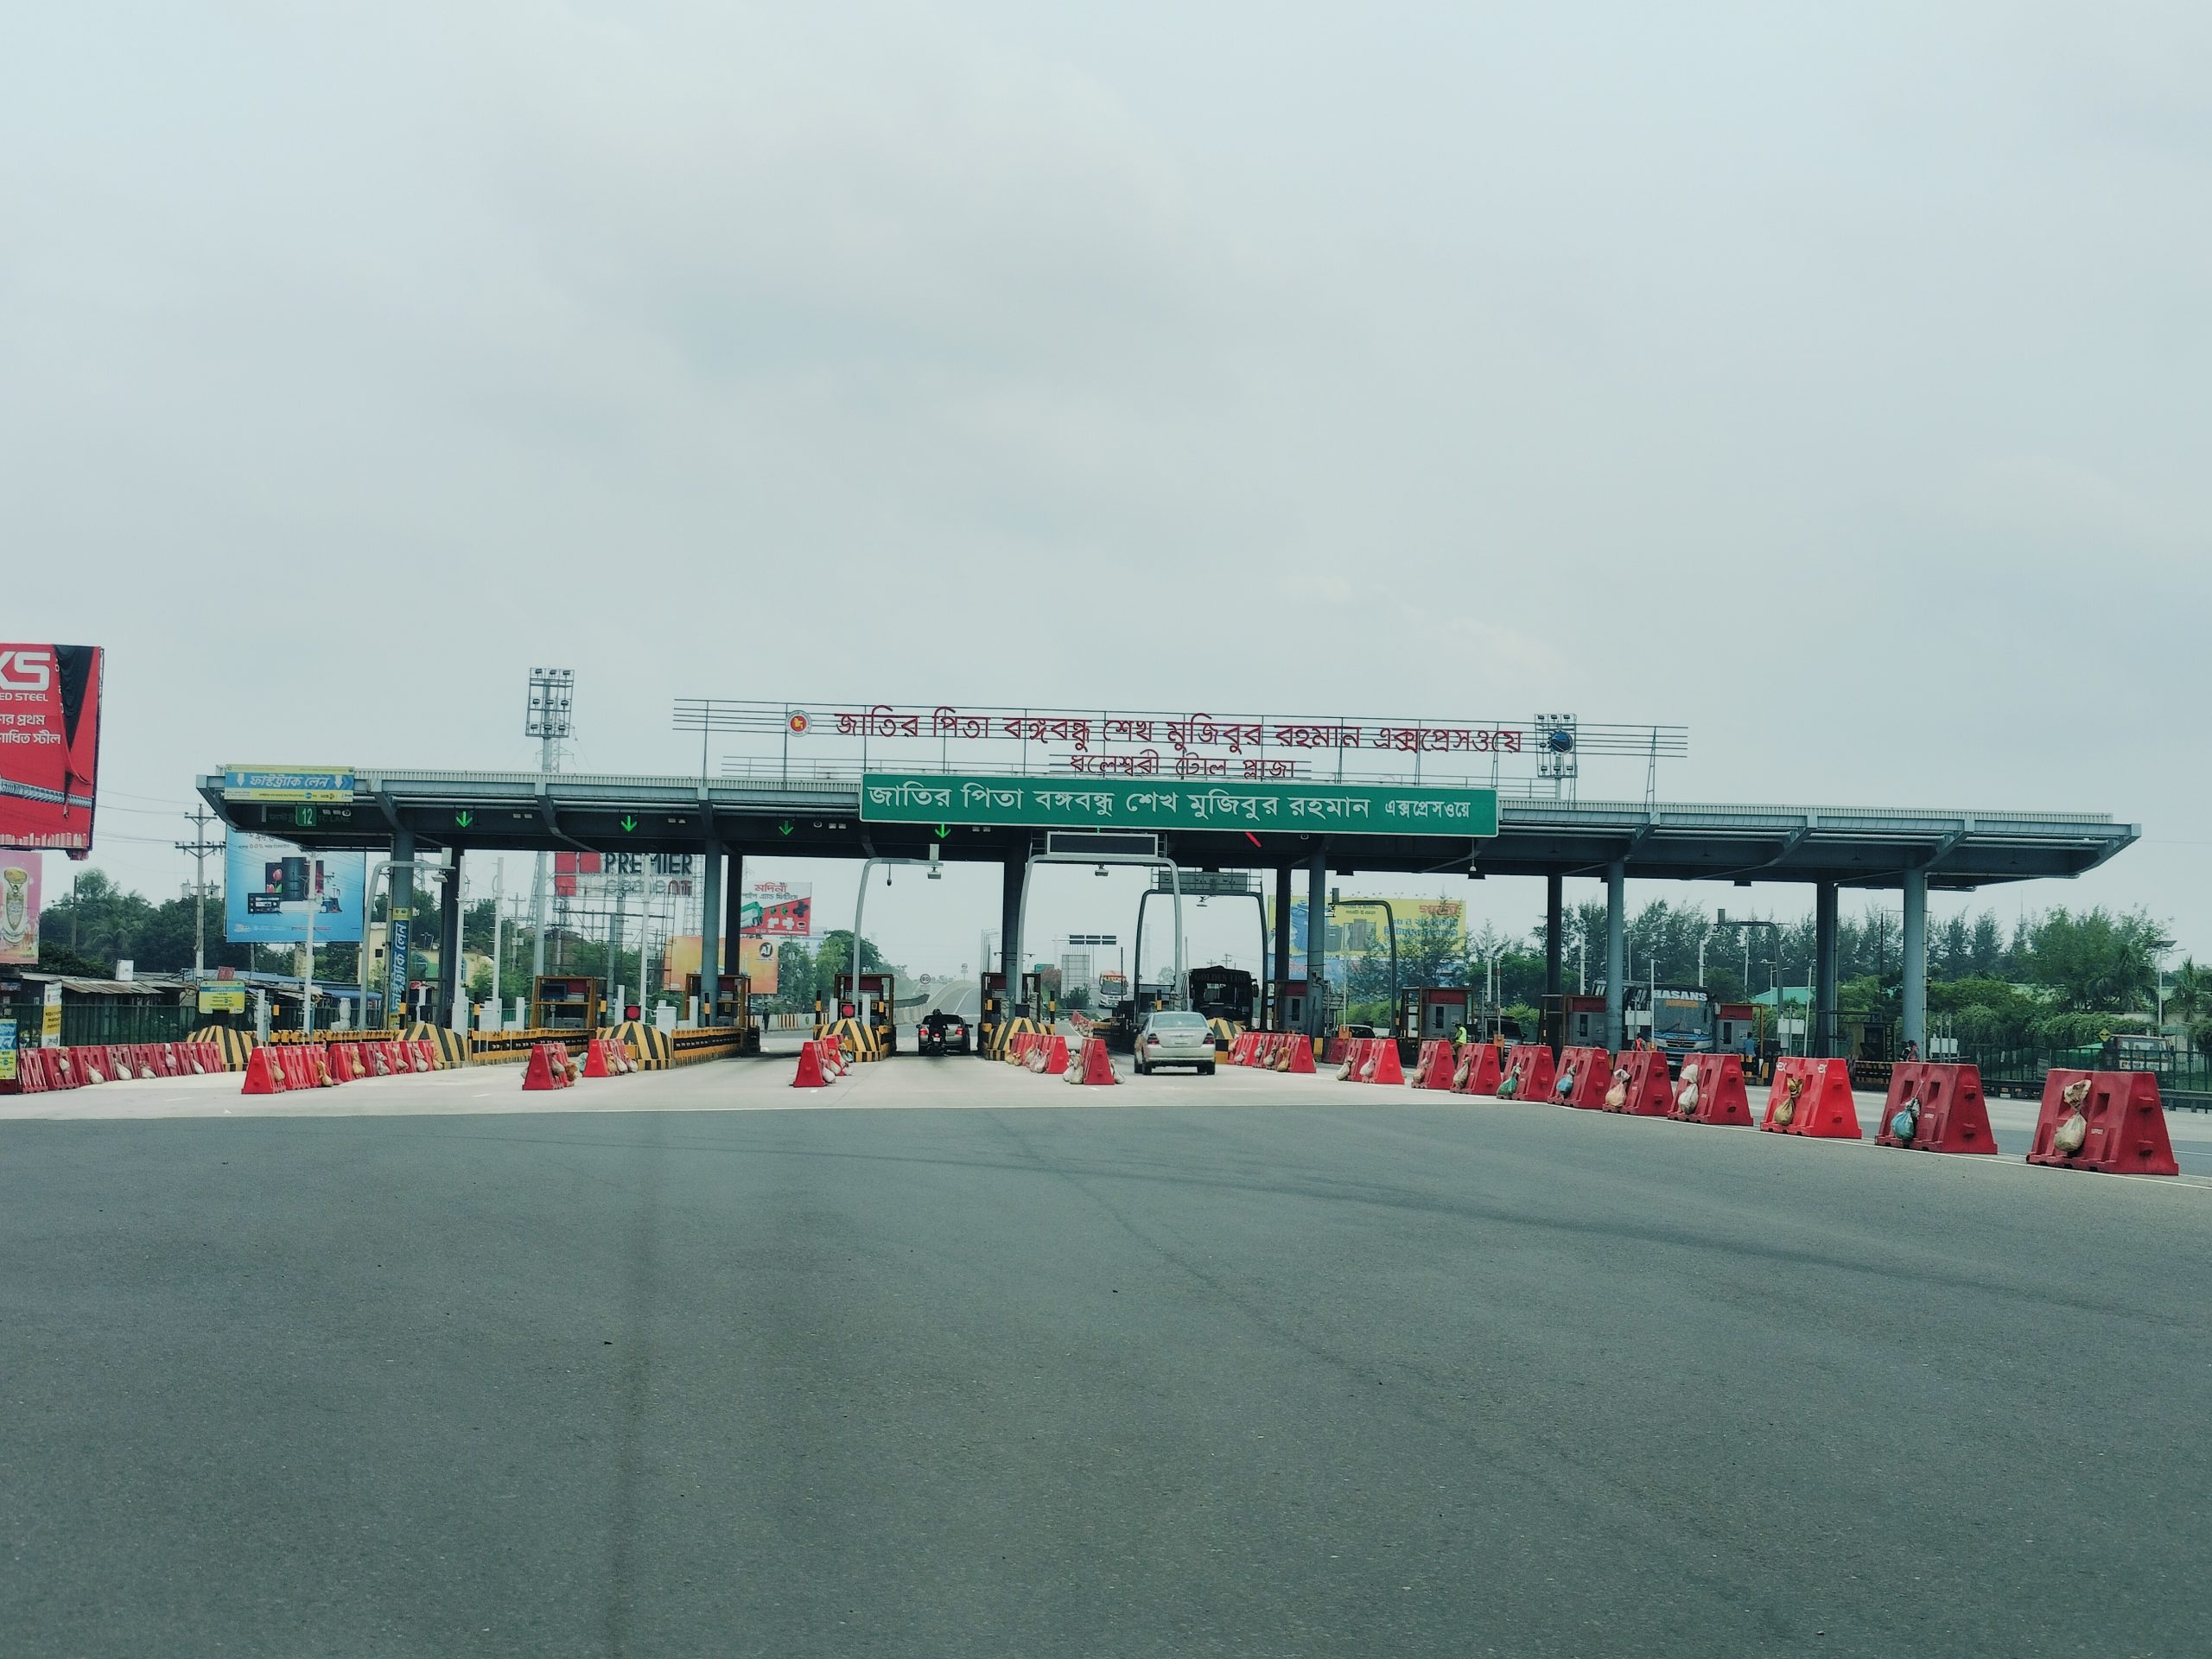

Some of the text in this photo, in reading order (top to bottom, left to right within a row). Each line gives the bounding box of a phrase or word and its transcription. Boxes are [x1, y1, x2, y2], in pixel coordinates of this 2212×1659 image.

[15, 693, 49, 702] STEEL
[17, 714, 46, 727] প্রথম
[834, 705, 919, 737] জাতির
[932, 707, 991, 739] পিতা
[1002, 717, 1092, 753] বঙ্গবন্ধু
[1103, 720, 1154, 742] শেখ
[1166, 713, 1263, 755] মুজিবুর
[1274, 725, 1362, 749] রহমান
[1175, 752, 1229, 776] টোল
[304, 777, 330, 788] লেন
[867, 780, 952, 808] জাতির
[960, 782, 1025, 810] পিতা
[1033, 791, 1116, 817] বঙ্গবন্ধু
[1126, 791, 1180, 813] শেখ
[1186, 788, 1281, 822] মুজিবুর
[1287, 796, 1371, 821] রহমান
[302, 808, 313, 824] 12
[605, 852, 693, 875] PREMIER
